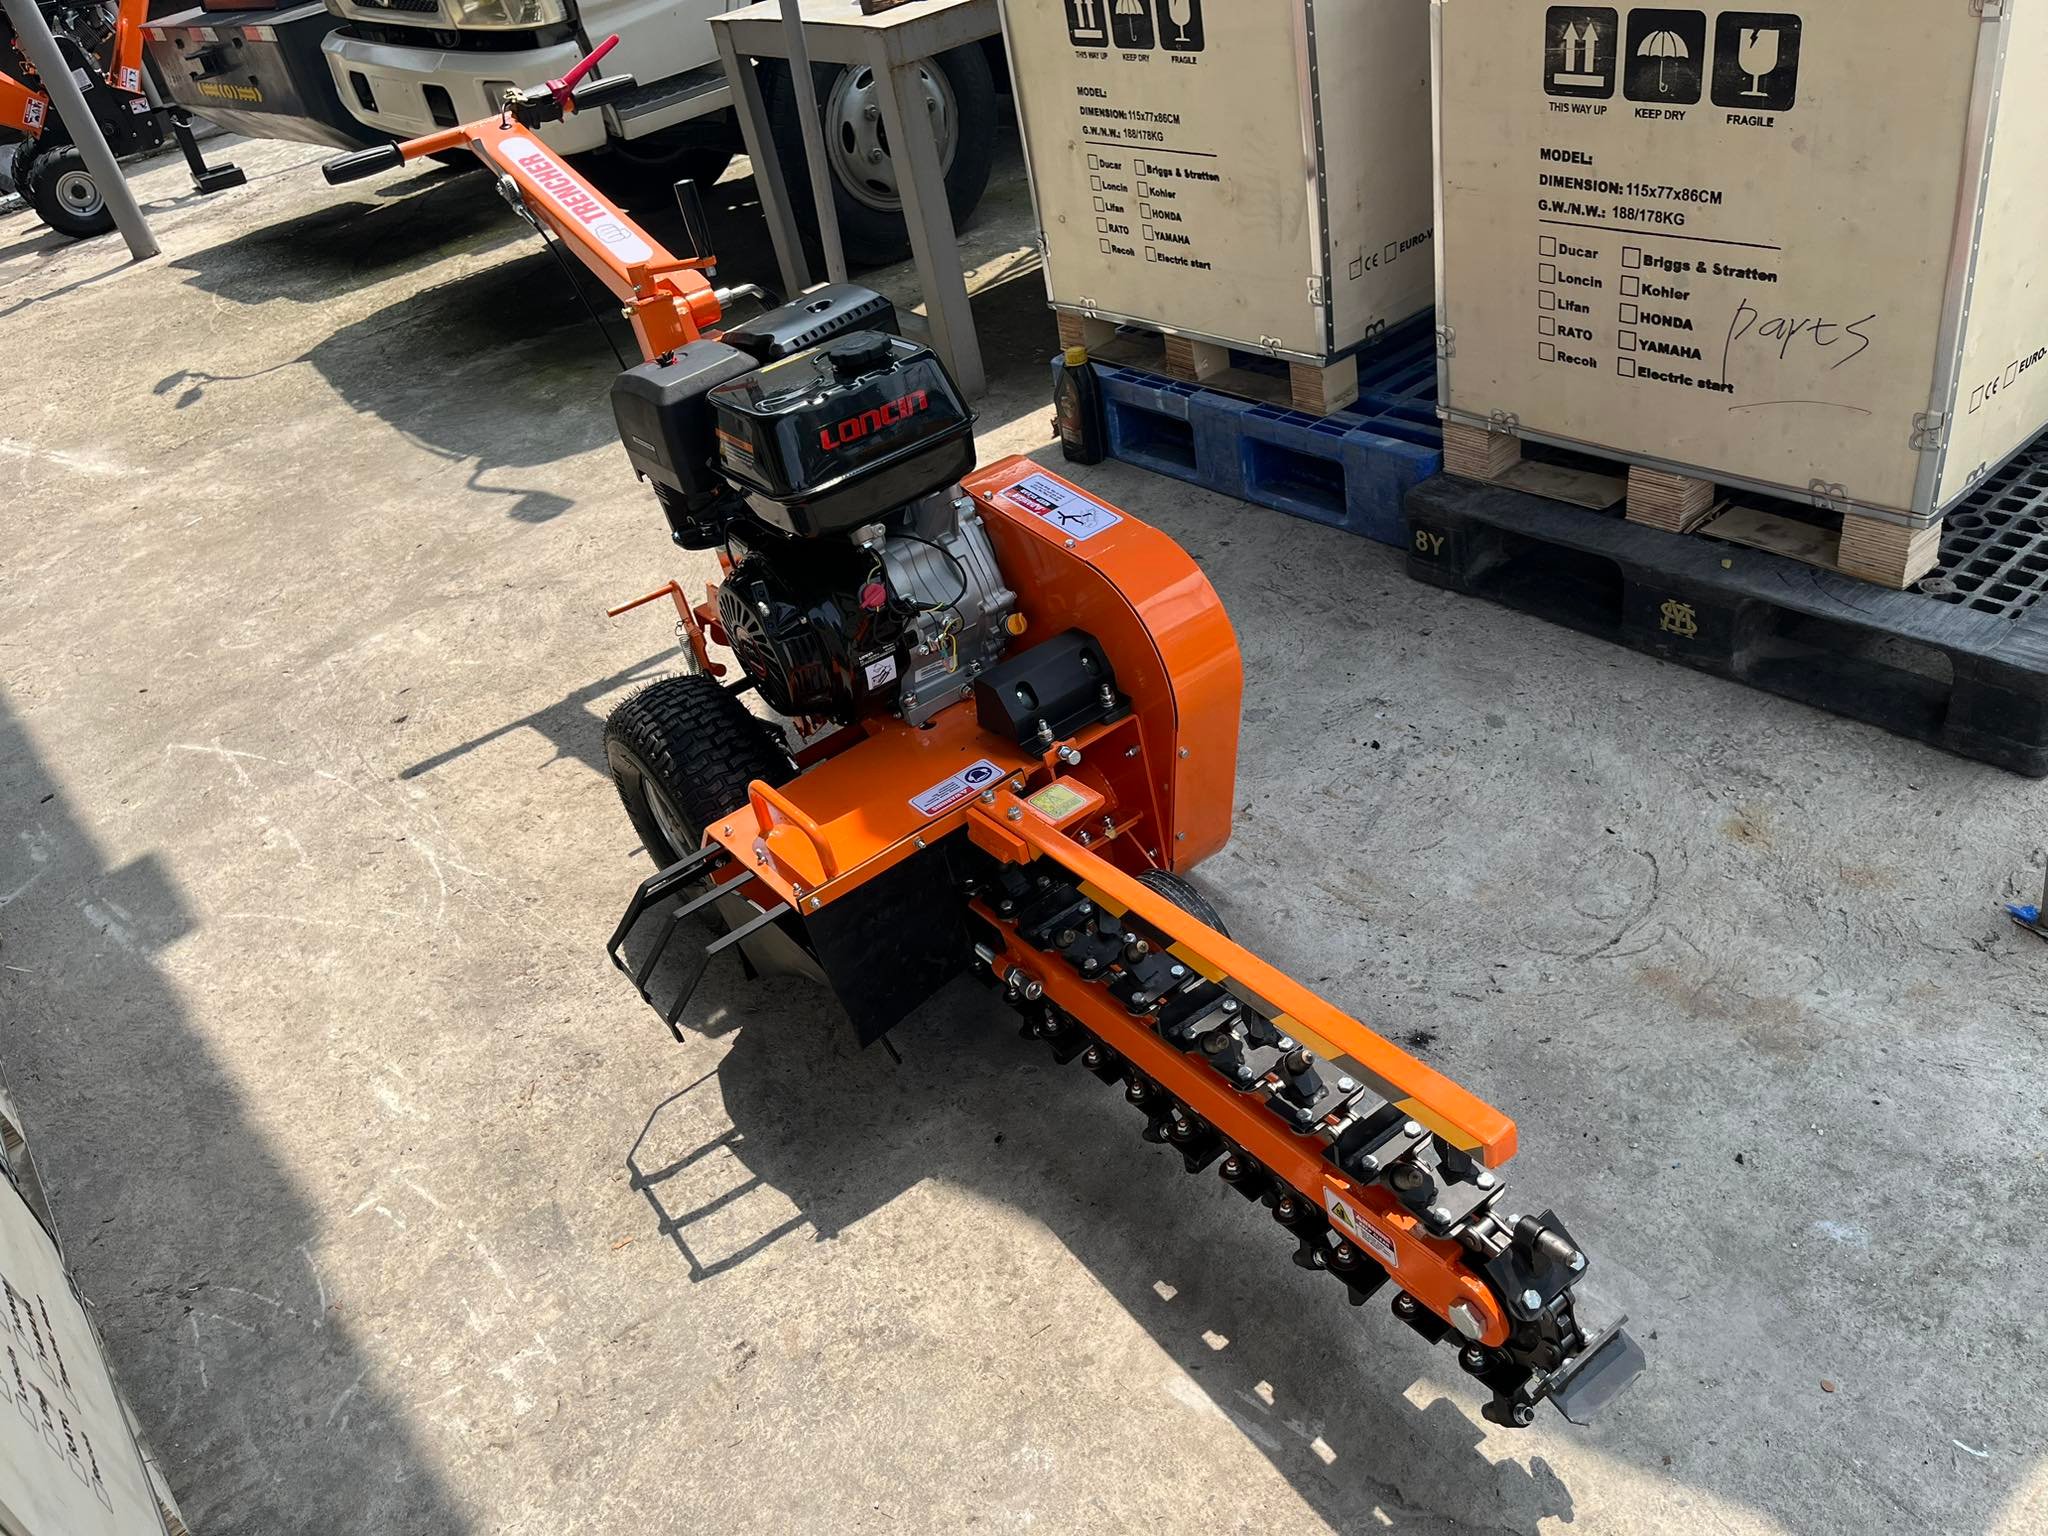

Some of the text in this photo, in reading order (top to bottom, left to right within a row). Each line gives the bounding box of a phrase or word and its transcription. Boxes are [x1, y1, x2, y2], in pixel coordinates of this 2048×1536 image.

[1122, 53, 1136, 61] KEEP
[1171, 56, 1197, 64] FRAGILE
[1077, 86, 1107, 98] MODEL:
[1080, 106, 1180, 124] DIMENSION: 115x77x86CM
[1548, 102, 1607, 116] THIS WAY UP
[1634, 108, 1686, 120] KEEP DRY
[1726, 114, 1774, 128] FRAGILE
[1082, 126, 1164, 142] G.W./N.W.: 188/178KG
[1100, 159, 1122, 170] Ducar
[1540, 148, 1593, 165] MODEL:
[1146, 164, 1172, 178] Briggs
[1175, 168, 1182, 178] &
[518, 153, 607, 224] TRENCHER
[1102, 180, 1128, 192] Loncin
[1150, 187, 1176, 199] Kohler
[1539, 174, 1722, 204] DIMENSION: 115x77x86CM
[1105, 202, 1124, 213] Lifan
[1152, 208, 1182, 222] HONDA
[1538, 200, 1685, 226] G.W./N.W.: 188/178KG
[1108, 224, 1129, 234] RATO
[1154, 230, 1190, 245] YAMAHA
[1559, 243, 1598, 258] Ducar
[1157, 252, 1211, 270] Electric start
[1643, 255, 1777, 283] Briggs & Stratton
[1558, 271, 1602, 288] Loncin
[1642, 284, 1690, 301] Kohler
[1558, 298, 1590, 314] Lifan
[1640, 311, 1693, 331] HONDA
[1558, 325, 1592, 341] RATO
[1722, 298, 1876, 384] parts
[1638, 338, 1702, 361] YAMAHA
[1638, 366, 1734, 394] Electric start
[1415, 530, 1444, 556] 8Y
[58, 1408, 80, 1458] RATO
